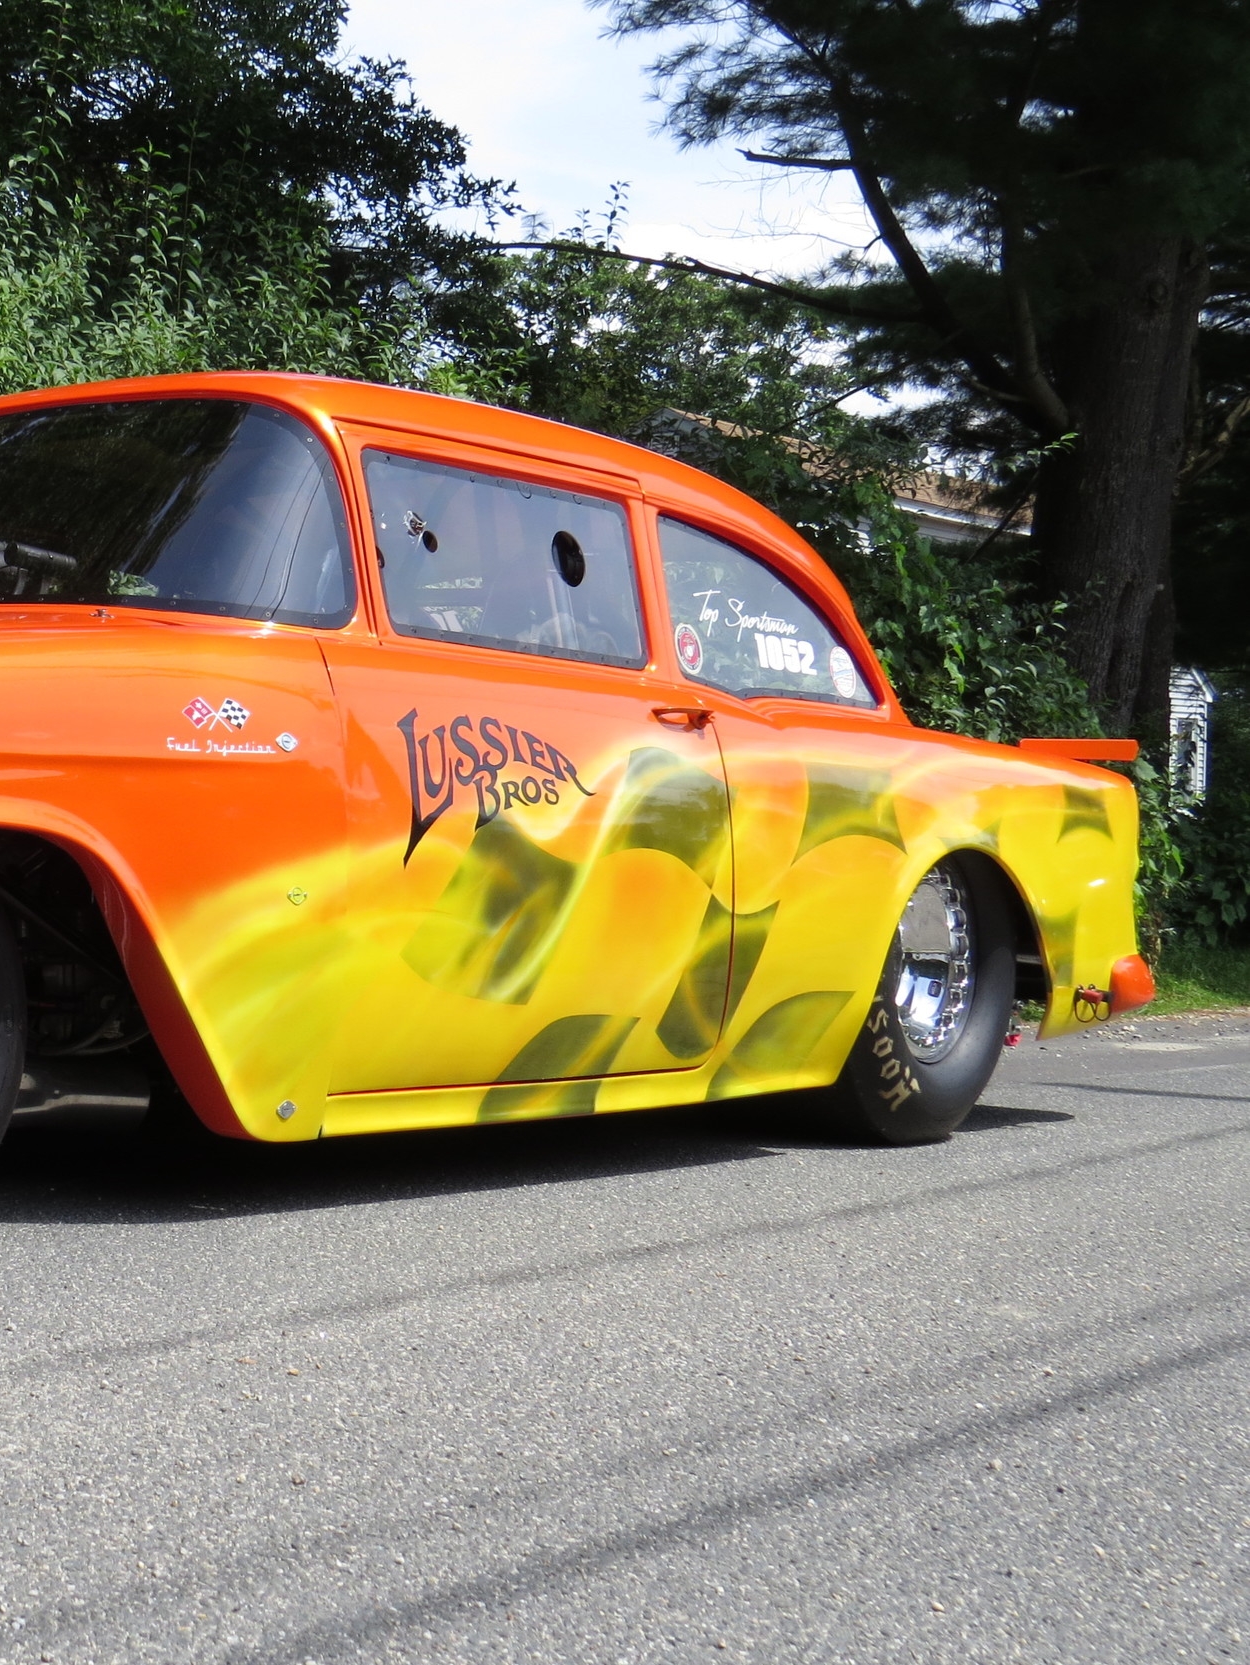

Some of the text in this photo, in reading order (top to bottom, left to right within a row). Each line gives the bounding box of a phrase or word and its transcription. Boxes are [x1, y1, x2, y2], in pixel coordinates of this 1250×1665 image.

[693, 589, 799, 642] Top Sportsman
[754, 632, 817, 675] 1052
[166, 737, 277, 757] Fuel Injection
[396, 707, 597, 870] LUSSIER
